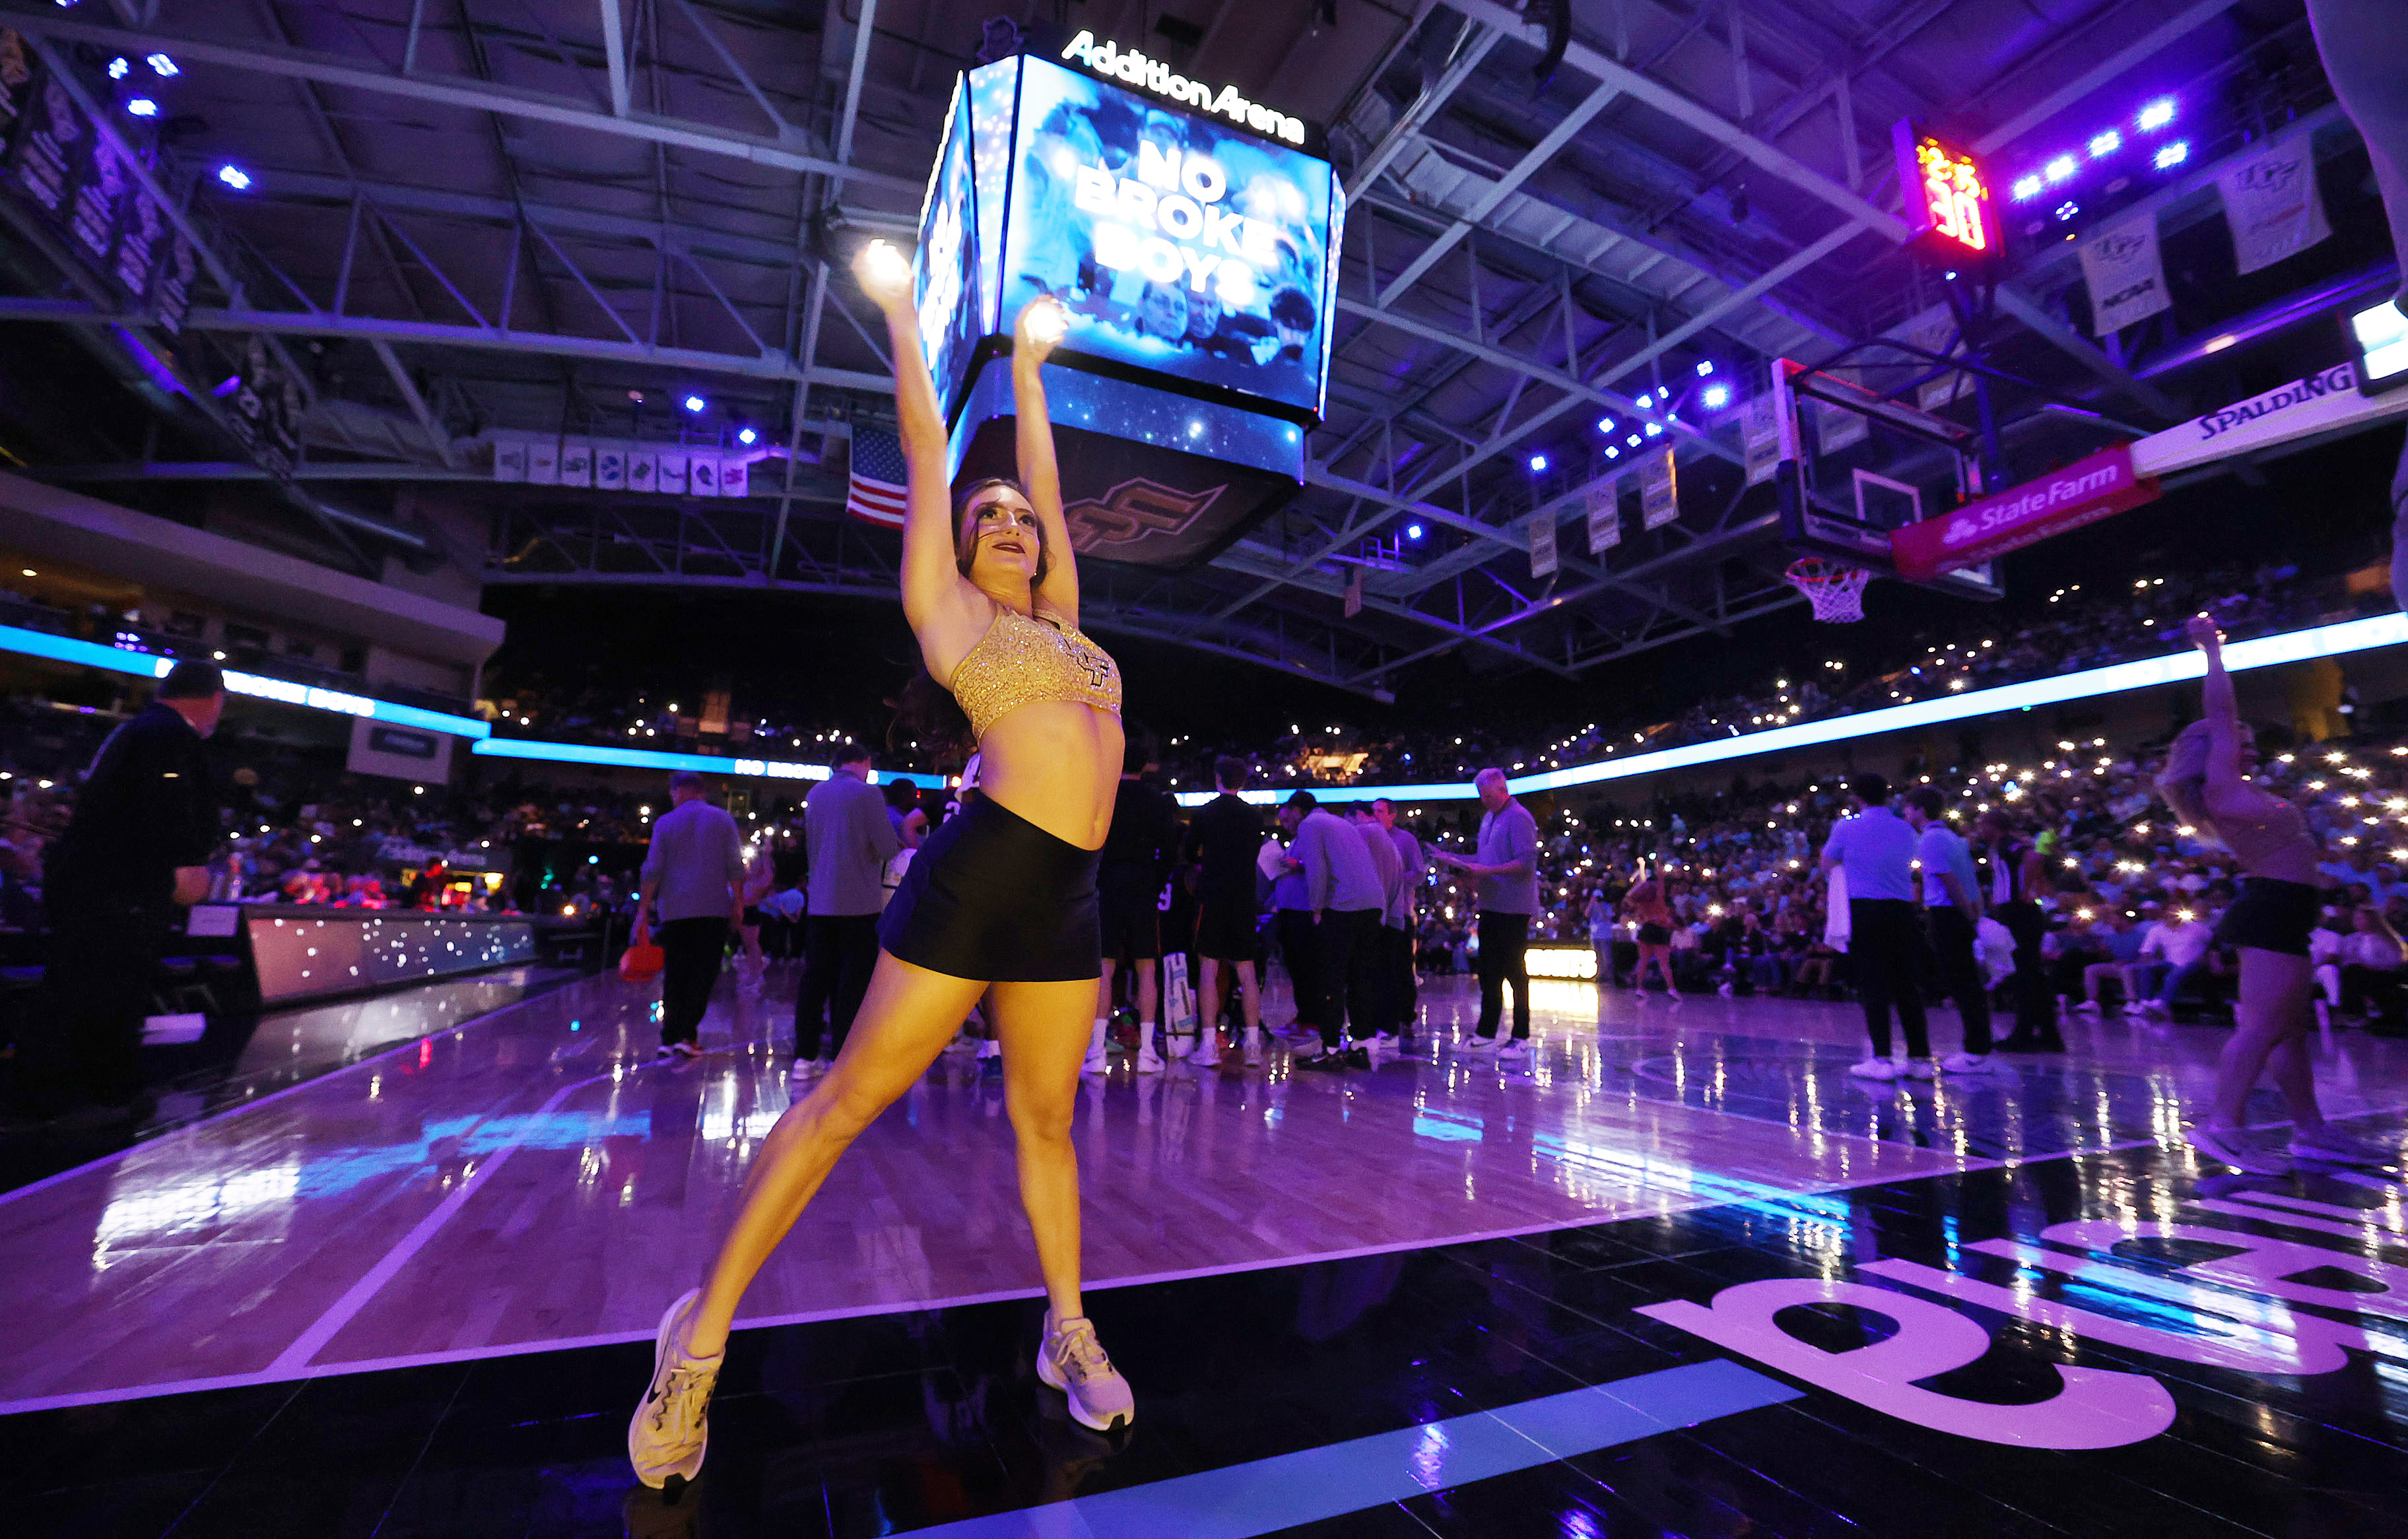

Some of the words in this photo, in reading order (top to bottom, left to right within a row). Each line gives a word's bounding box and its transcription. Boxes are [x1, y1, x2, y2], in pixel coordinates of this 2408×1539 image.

[1137, 139, 1226, 203] NO
[1075, 164, 1279, 267] BROKE
[1094, 222, 1255, 306] BOYS
[2199, 365, 2353, 441] SPALDING
